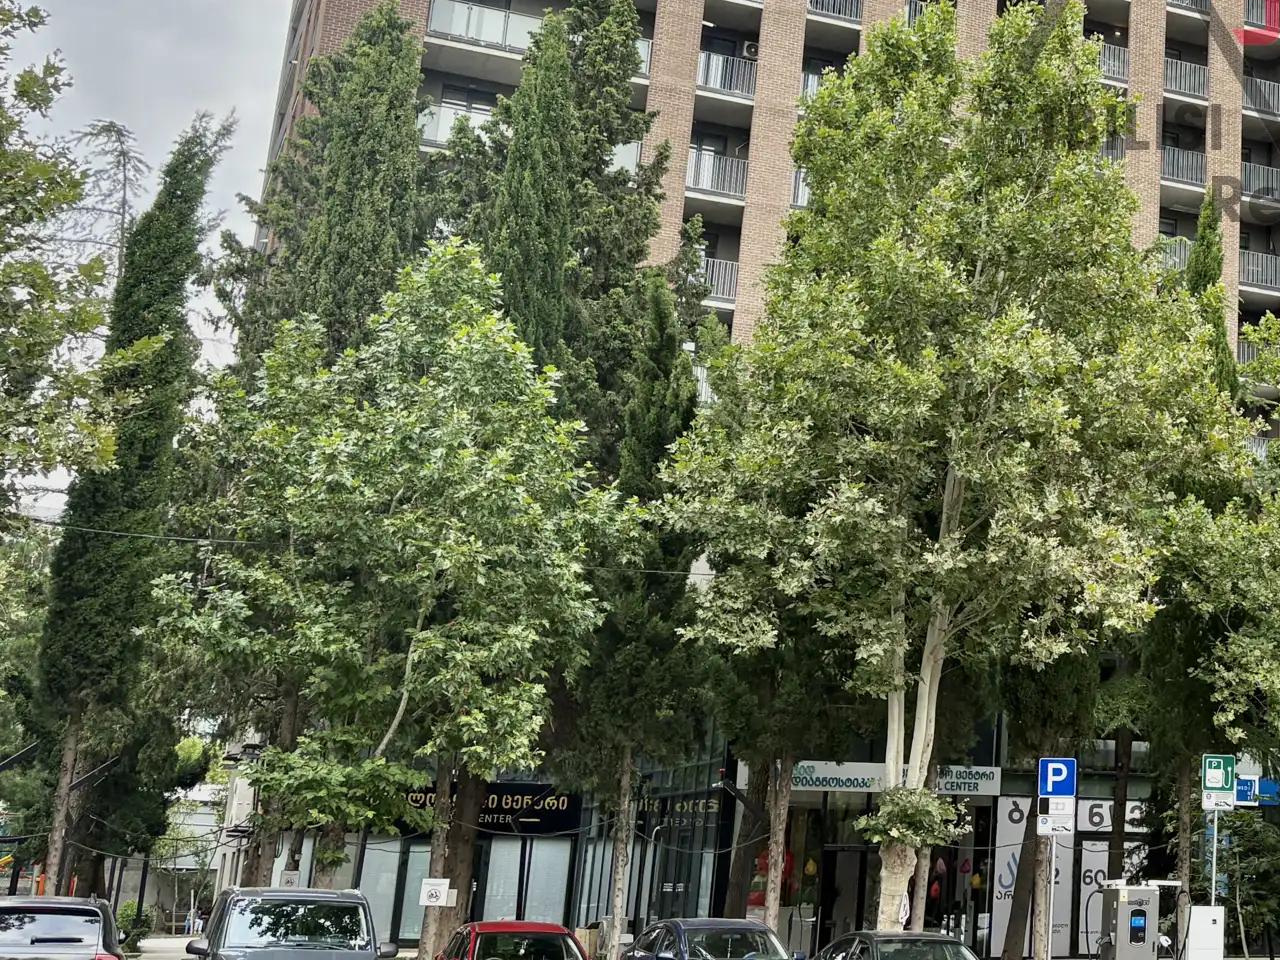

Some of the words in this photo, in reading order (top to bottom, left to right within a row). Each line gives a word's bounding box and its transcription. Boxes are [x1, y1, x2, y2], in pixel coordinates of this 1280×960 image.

[1046, 762, 1068, 793] P
[944, 781, 979, 792] CENTER
[478, 813, 512, 824] ENTER
